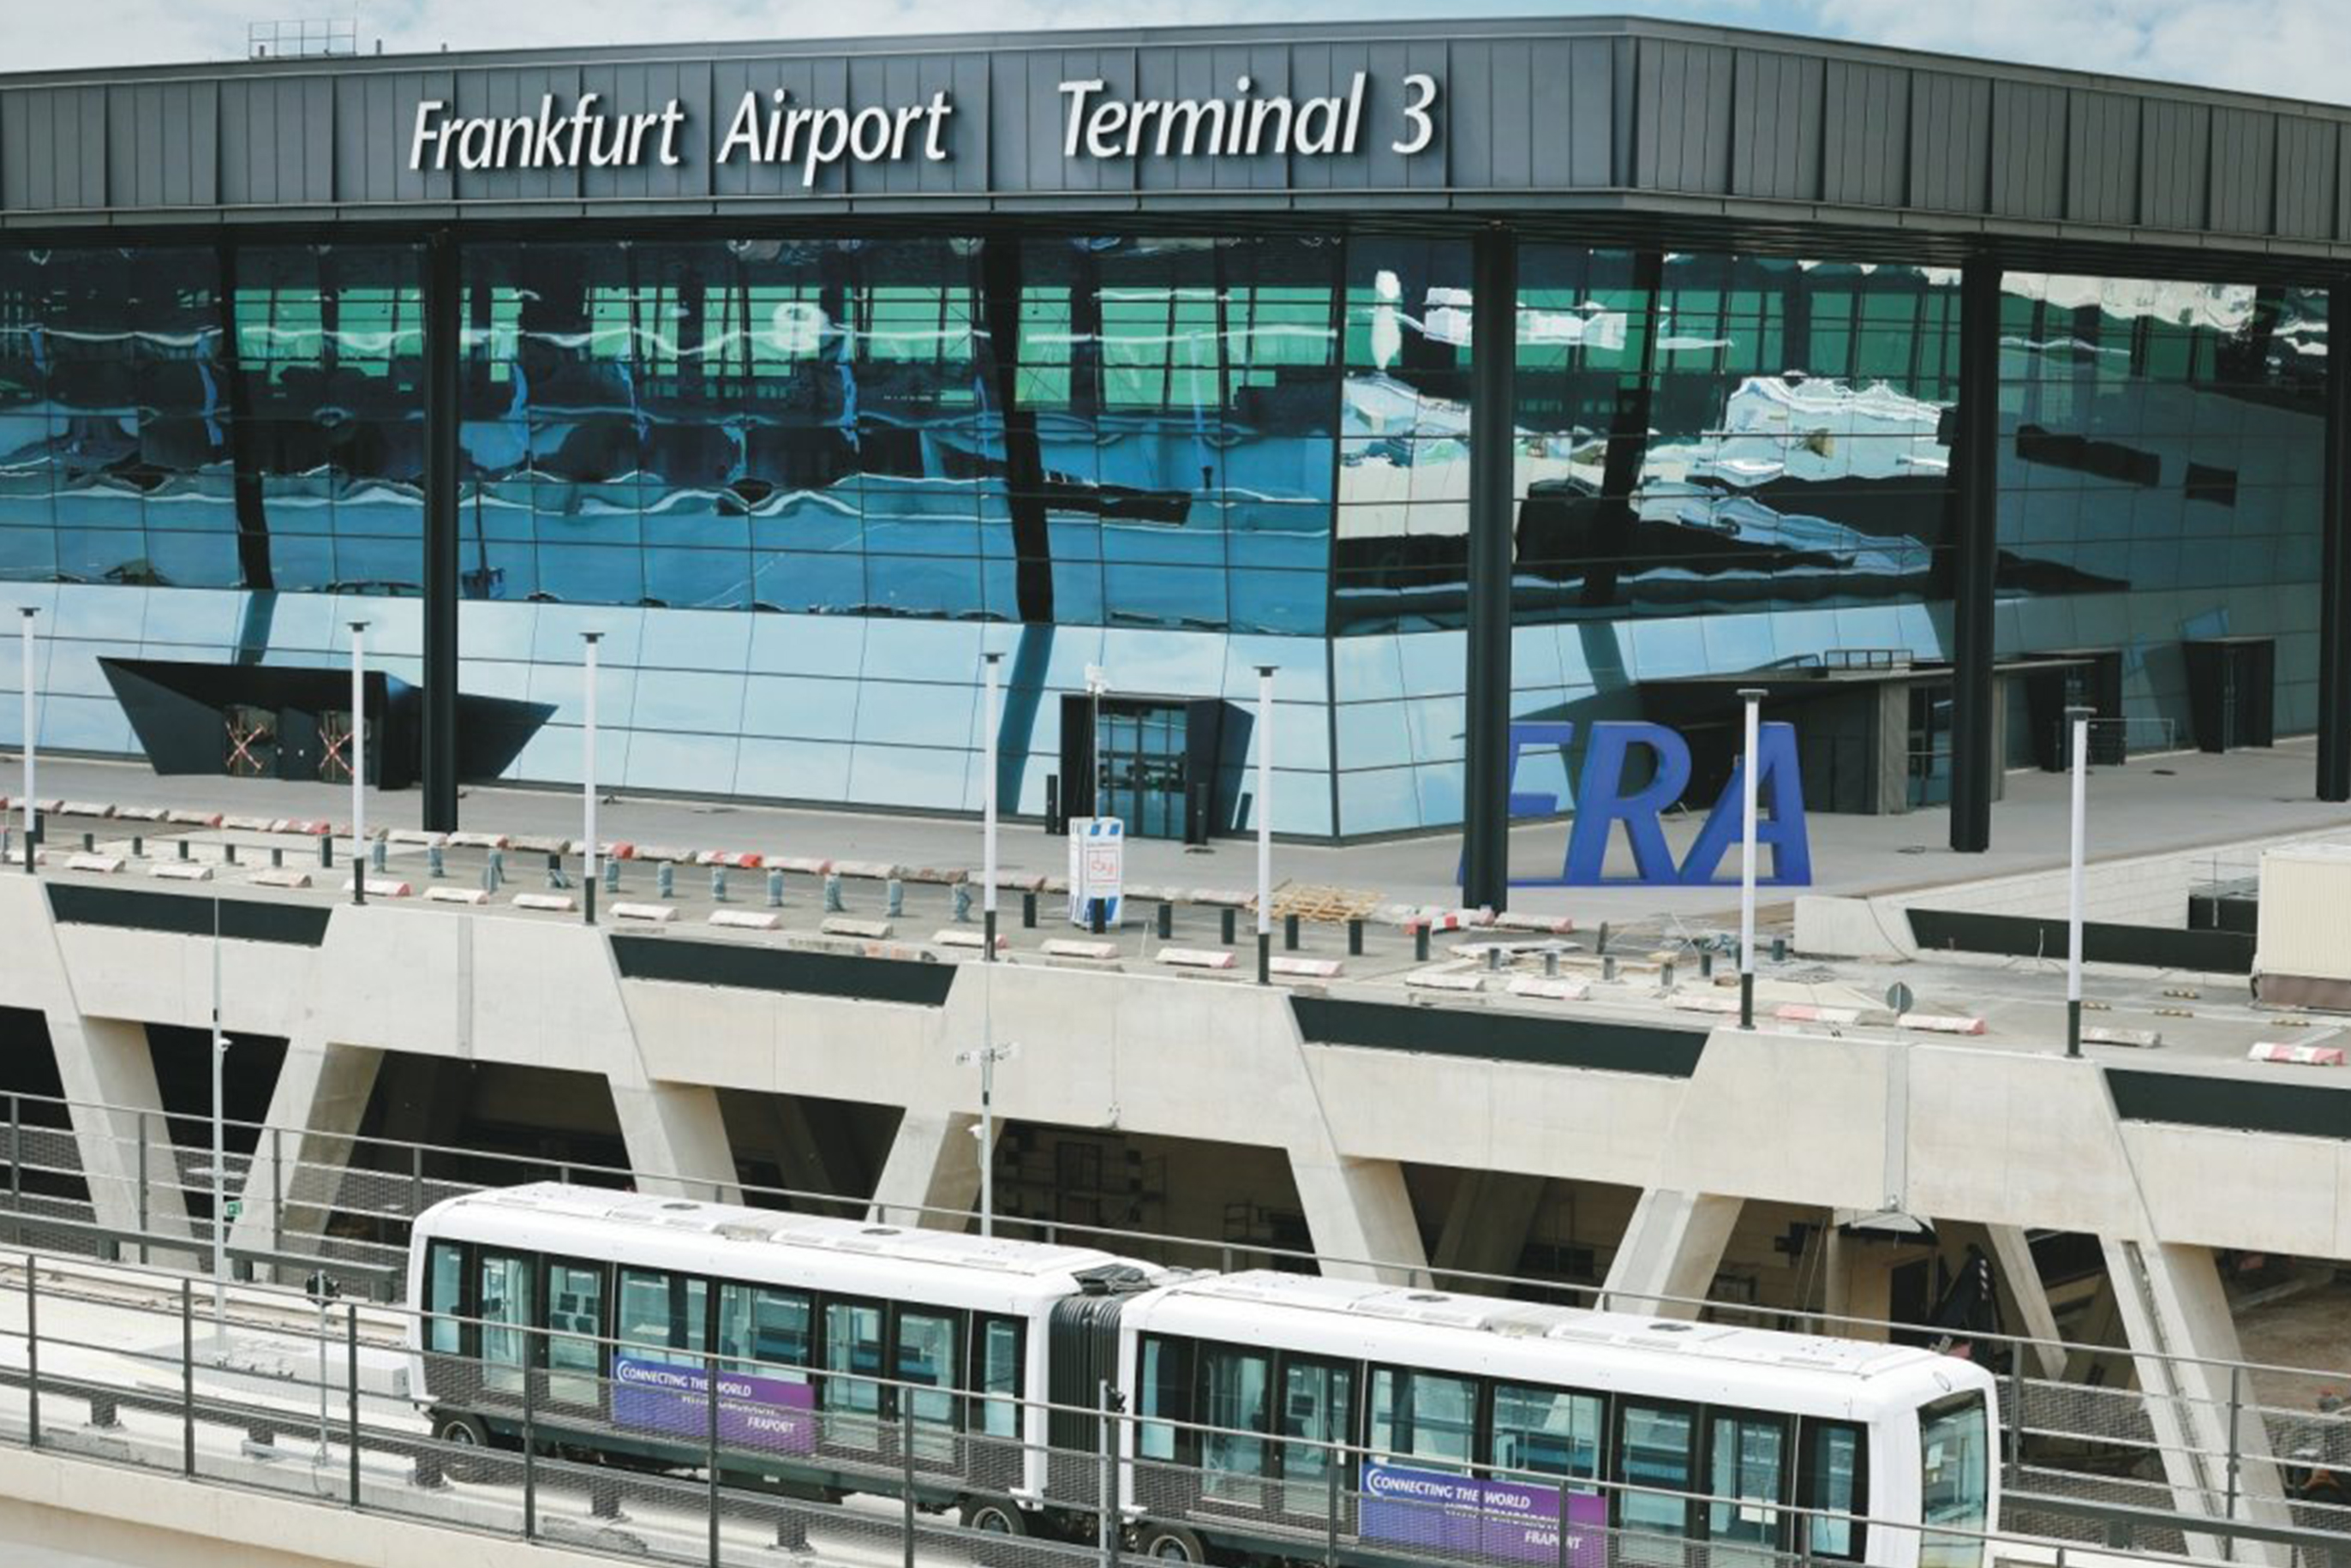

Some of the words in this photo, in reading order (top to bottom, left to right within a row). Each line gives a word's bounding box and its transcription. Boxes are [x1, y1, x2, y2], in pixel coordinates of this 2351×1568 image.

[410, 93, 684, 169] Frankfurt
[716, 89, 952, 186] Airport
[1058, 72, 1367, 157] Terminal
[1391, 74, 1437, 154] 3
[623, 1367, 688, 1388] CONNECTING
[690, 1376, 709, 1391] THE
[748, 1416, 795, 1433] FRAPORT
[1373, 1475, 1453, 1499] CONNECTING
[1456, 1487, 1479, 1502] THE
[1484, 1491, 1531, 1509] WORLD
